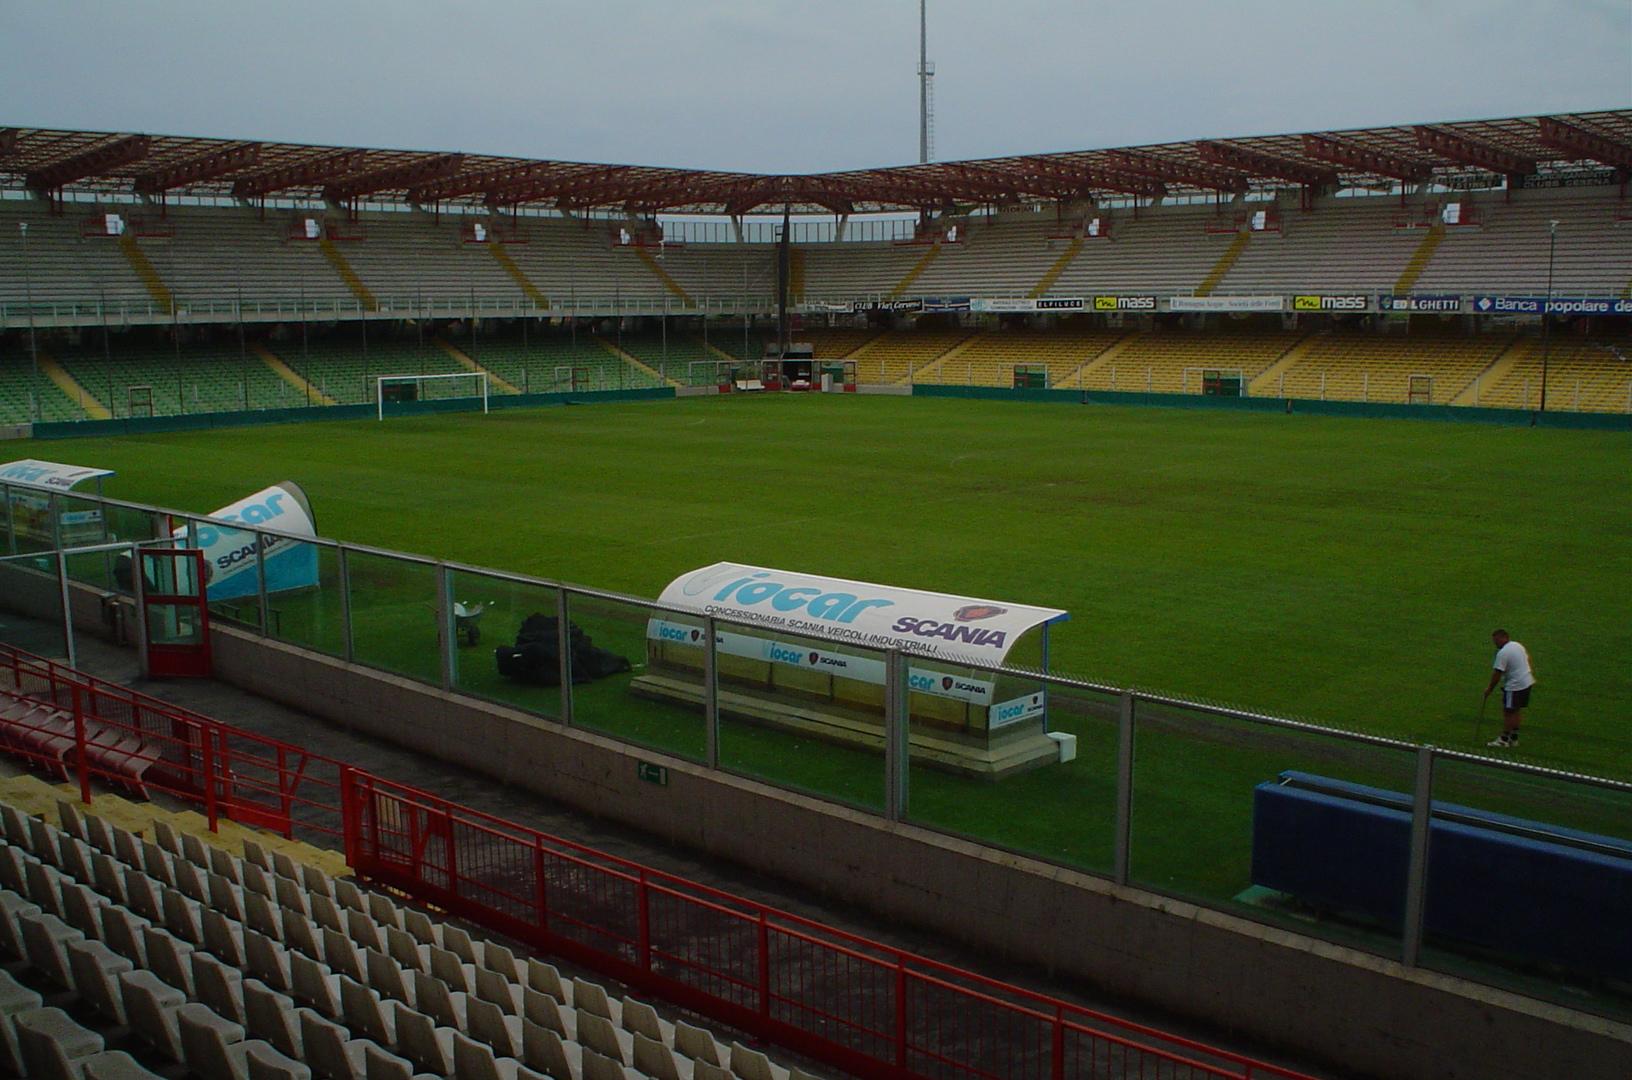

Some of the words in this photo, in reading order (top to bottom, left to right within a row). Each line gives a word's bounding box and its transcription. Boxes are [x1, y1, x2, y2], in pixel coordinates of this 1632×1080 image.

[1117, 297, 1154, 308] mass
[1321, 297, 1365, 308] mass
[1495, 298, 1537, 310] Banca
[1545, 300, 1608, 313] popolare
[714, 573, 895, 624] iocar
[659, 623, 687, 641] iocar
[704, 604, 786, 626] CONCESSIONARIA
[787, 619, 825, 634] SCANIA
[828, 625, 868, 642] VEICOLI
[868, 633, 938, 653] INDUSTRIALI
[892, 617, 1008, 649] SCANIA
[770, 642, 803, 664] iocar
[821, 655, 847, 668] SCANIA
[998, 703, 1025, 720] iocar
